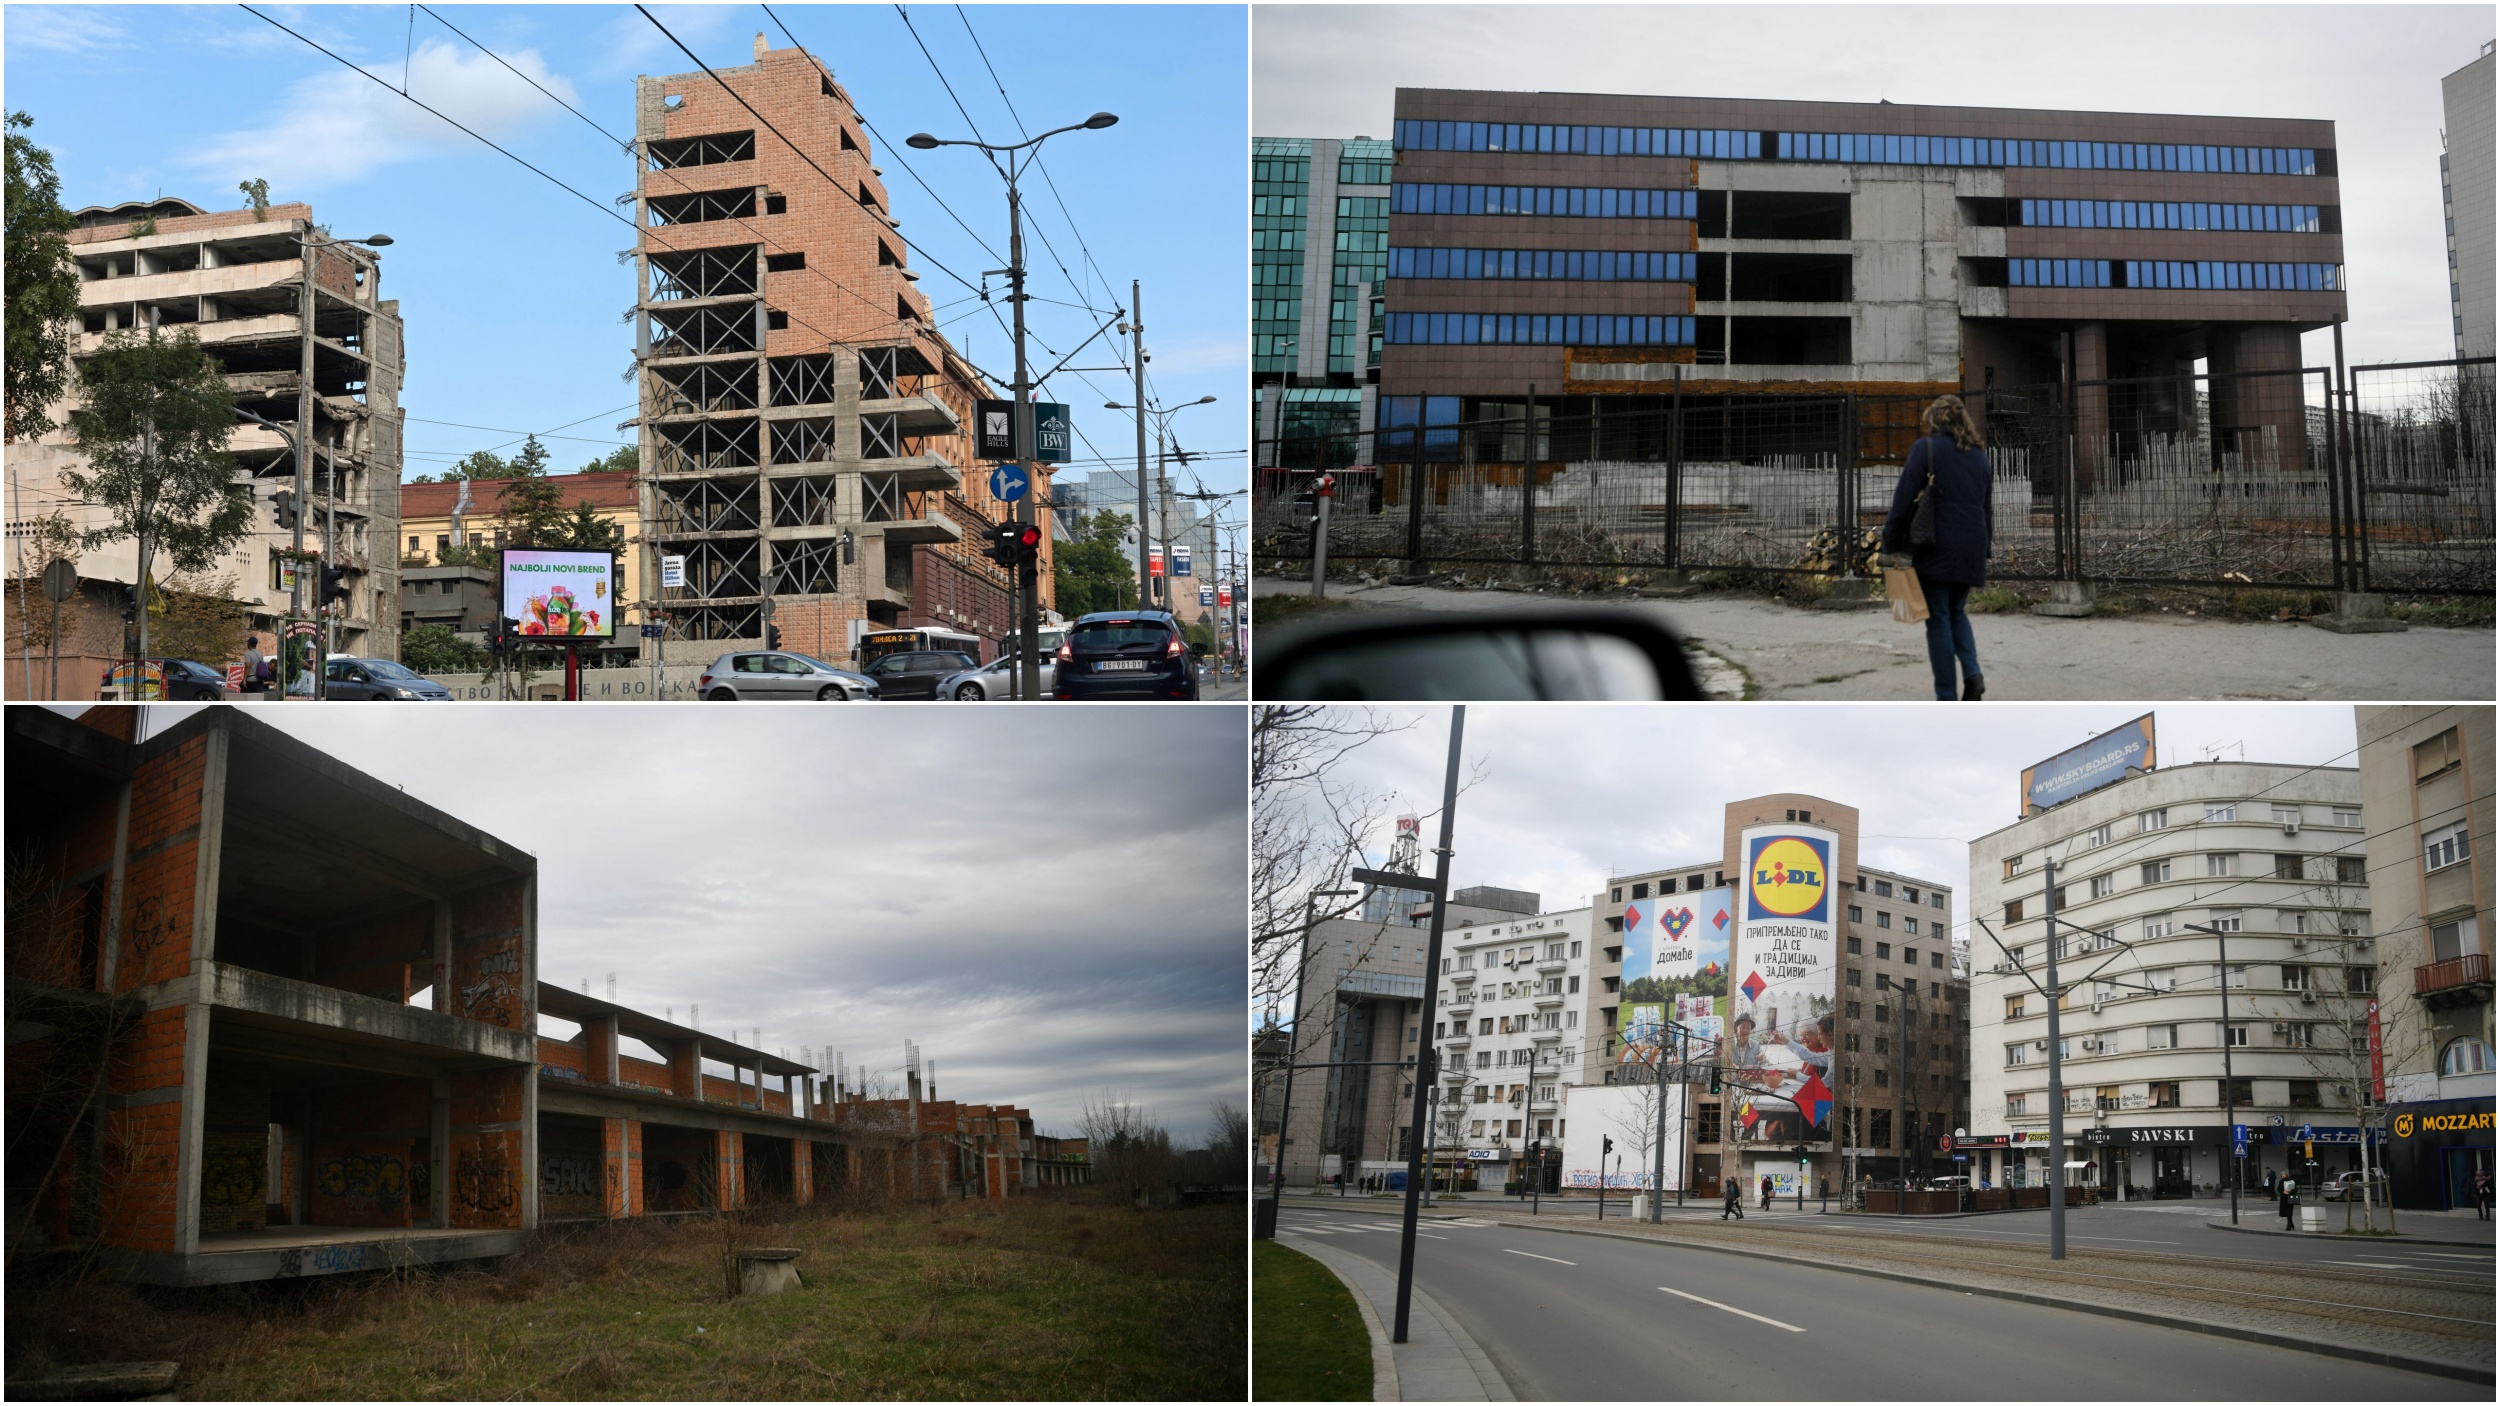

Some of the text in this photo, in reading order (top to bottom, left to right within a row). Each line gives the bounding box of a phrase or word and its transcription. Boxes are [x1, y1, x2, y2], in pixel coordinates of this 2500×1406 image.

[1042, 433, 1065, 448] BW
[509, 563, 606, 574] NAJBOLJI NOVI BREND
[447, 686, 491, 700] ТВО
[601, 682, 611, 695] И
[2035, 741, 2140, 793] WWW.SKYBOARD.RS
[1746, 925, 1829, 941] ПРИПРЕМЉЕНО ТАКО
[1772, 938, 1802, 951] ДА СЕ
[1754, 952, 1818, 966] И ТРАДИЦИЈА
[1765, 965, 1806, 979] ЗАДИВИ!
[2370, 1017, 2382, 1092] HOSTEL
[2422, 1113, 2497, 1131] MOZZART
[2087, 1132, 2111, 1141] bistro
[2131, 1129, 2195, 1142] SAVSKI
